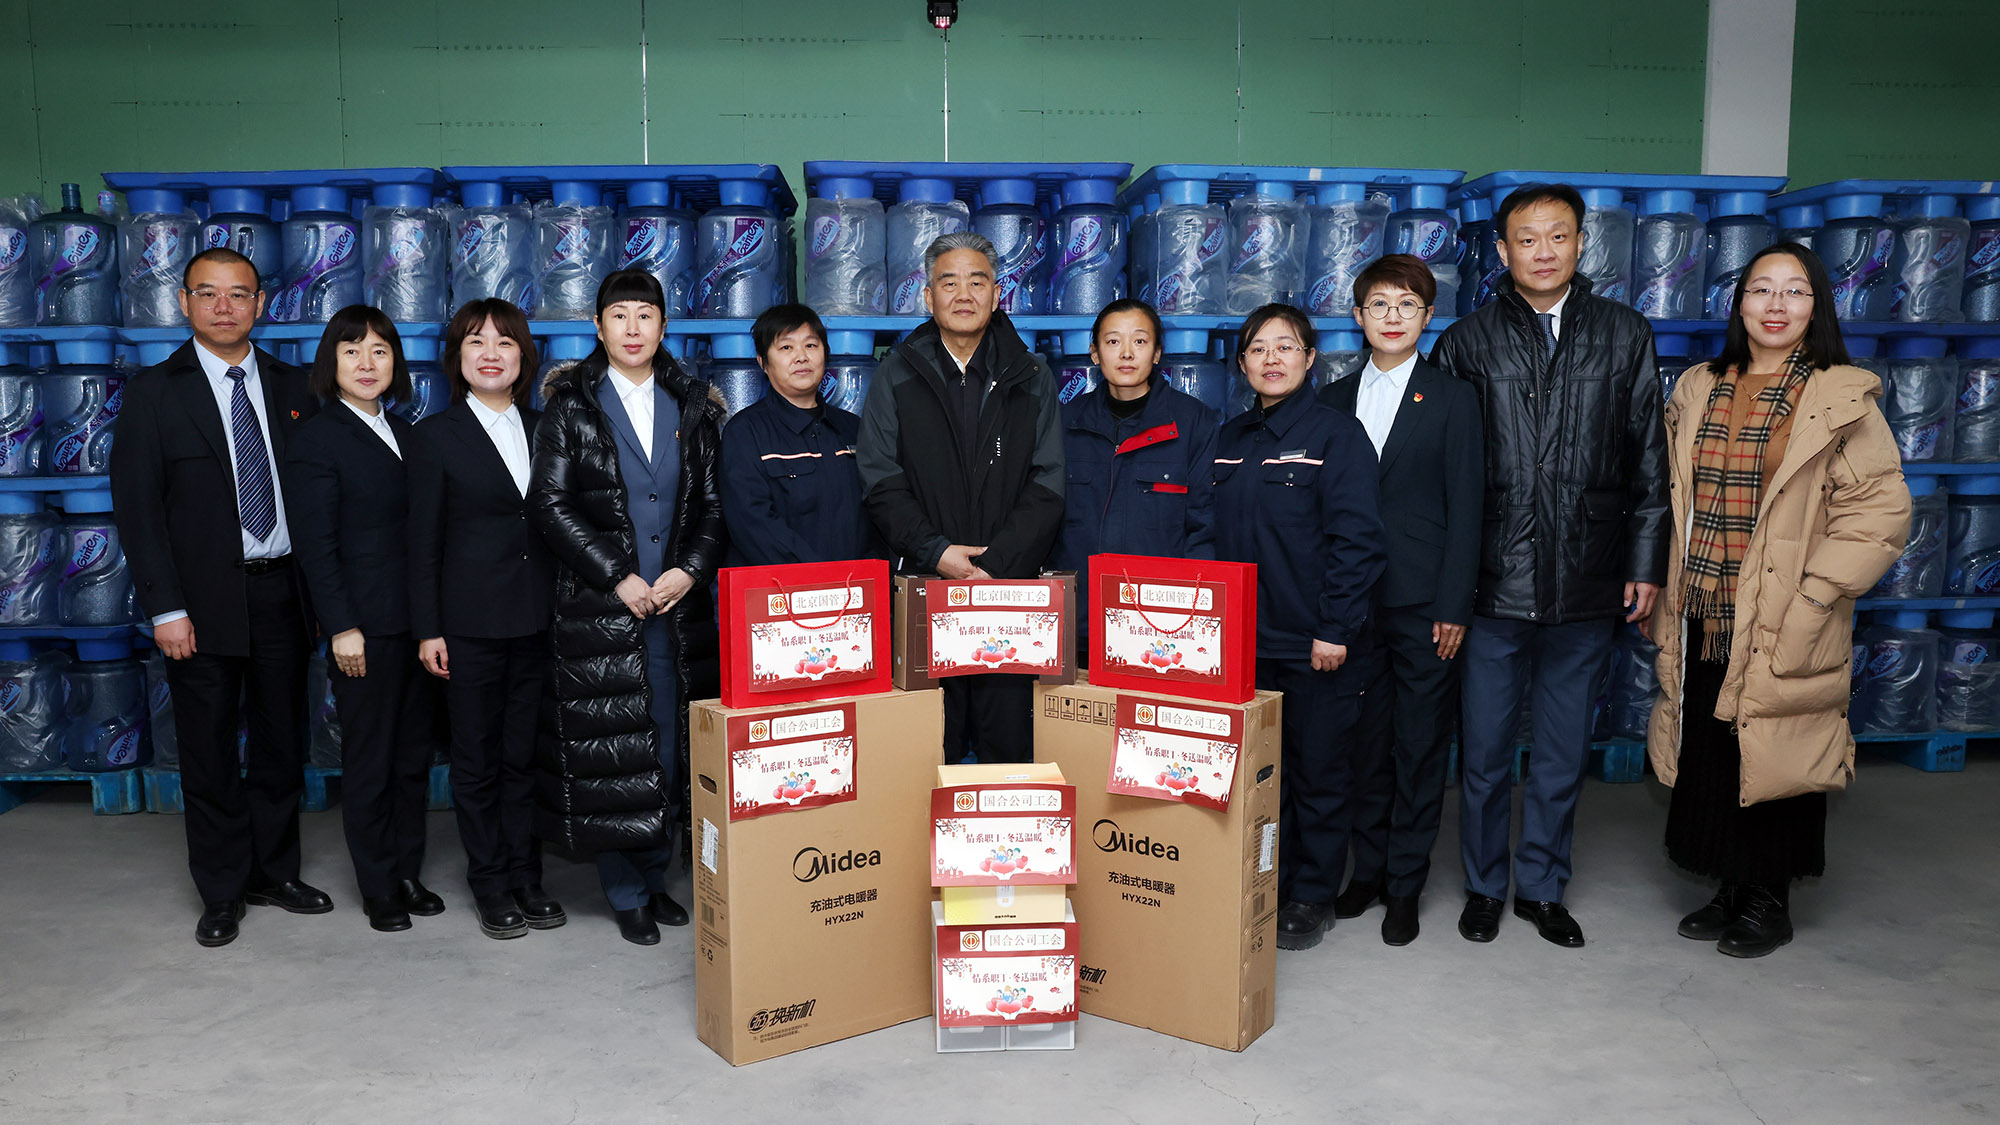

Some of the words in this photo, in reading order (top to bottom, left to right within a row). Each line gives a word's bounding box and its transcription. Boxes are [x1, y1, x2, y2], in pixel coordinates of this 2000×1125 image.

[976, 590, 1047, 603] 北京国管工会
[776, 715, 841, 734] 国合公司工会
[1161, 711, 1228, 732] 国合公司工会
[984, 795, 1058, 807] 国合公司工会
[1092, 819, 1180, 861] Midea
[793, 846, 881, 882] Midea
[1108, 871, 1175, 895] 充油式电暖器
[810, 888, 878, 913] 充油式电暖器
[1122, 892, 1161, 907] HYX22N
[825, 910, 864, 926] HYX22N
[989, 933, 1062, 946] 国合公司工会
